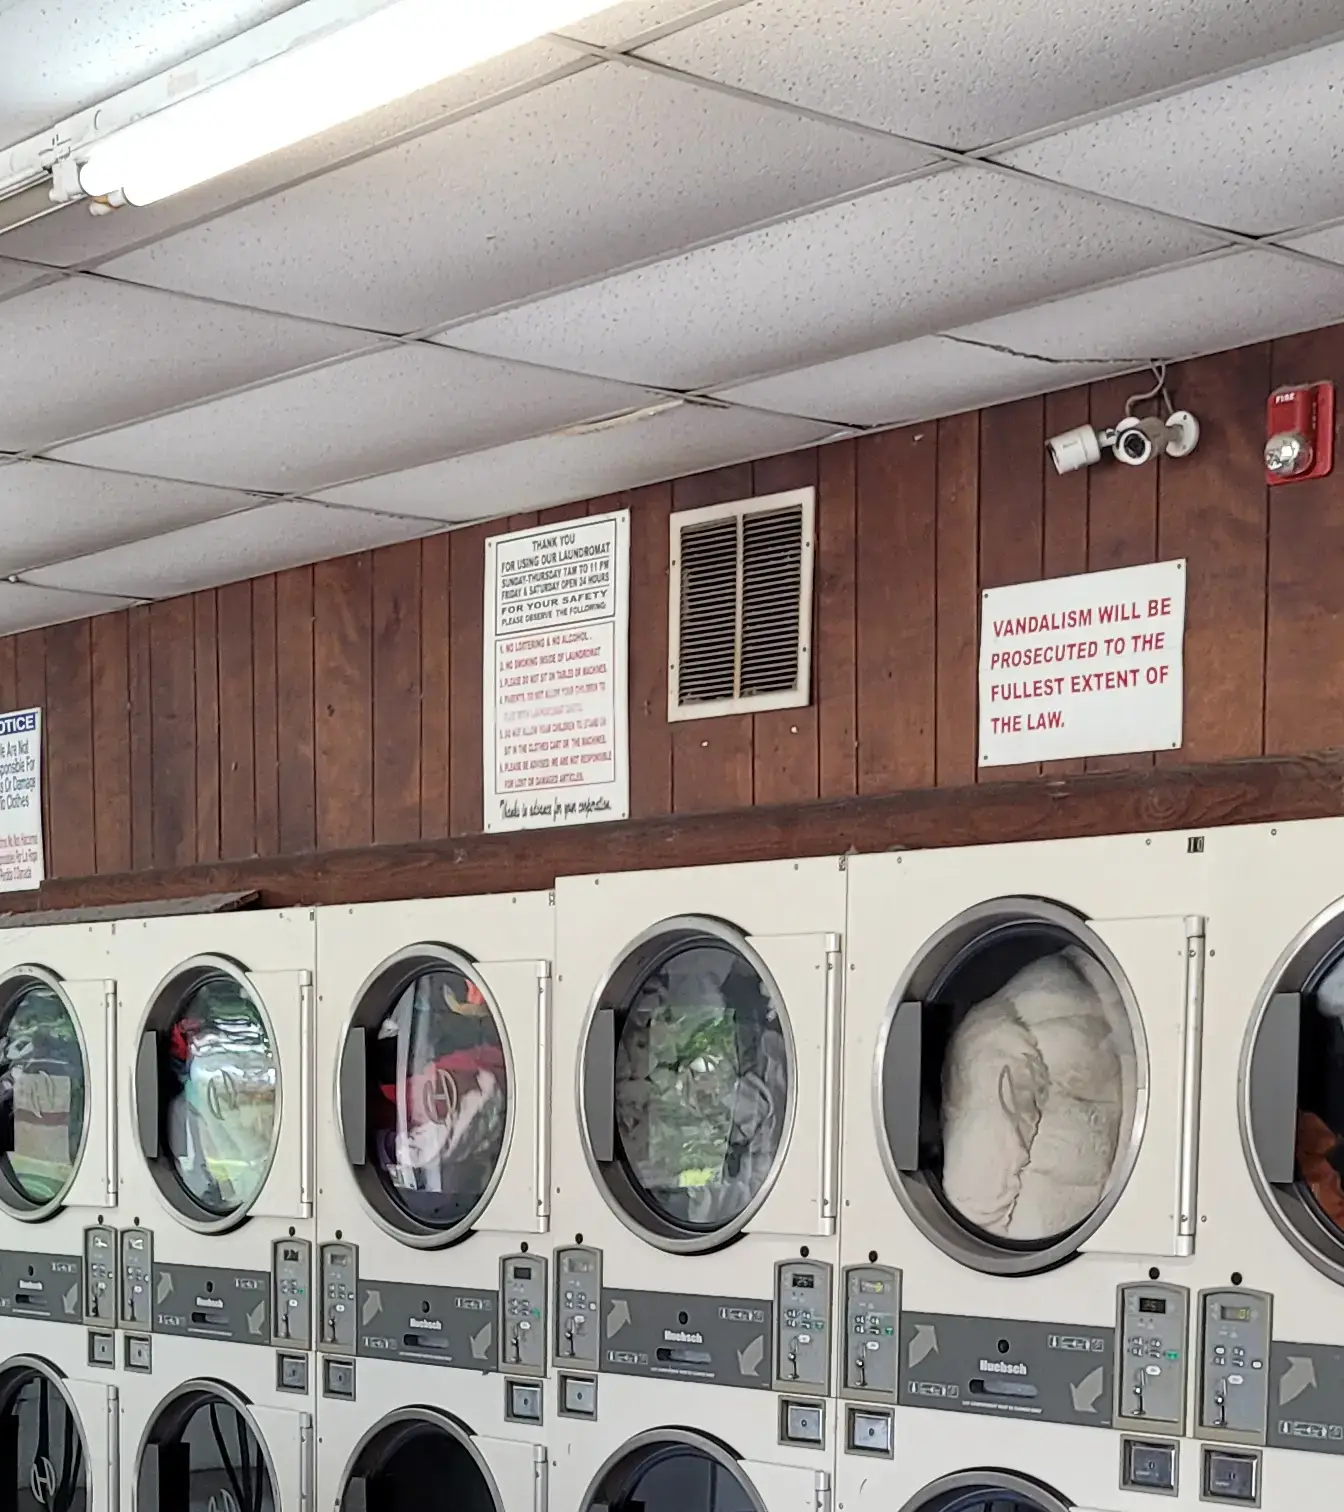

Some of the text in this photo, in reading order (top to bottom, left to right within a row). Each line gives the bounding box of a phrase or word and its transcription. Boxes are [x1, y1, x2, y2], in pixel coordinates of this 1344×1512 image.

[1275, 392, 1295, 404] FIRE
[532, 533, 575, 551] THANK YOU
[501, 542, 610, 573] FOR USING OUR LAUNDROMAT
[579, 563, 588, 574] TO
[501, 589, 608, 615] FOR YOUR SAFETY
[501, 615, 524, 627] PLEASE
[525, 610, 553, 622] OBSERVE
[556, 607, 568, 617] THE
[993, 597, 1172, 638] VANDALISM WILL BE
[990, 632, 1165, 670] PROSECUTED TO THE
[991, 665, 1169, 702] FULLEST EXTENT OF
[991, 711, 1065, 735] THE LAW.
[979, 1359, 1027, 1375] Huebsch
